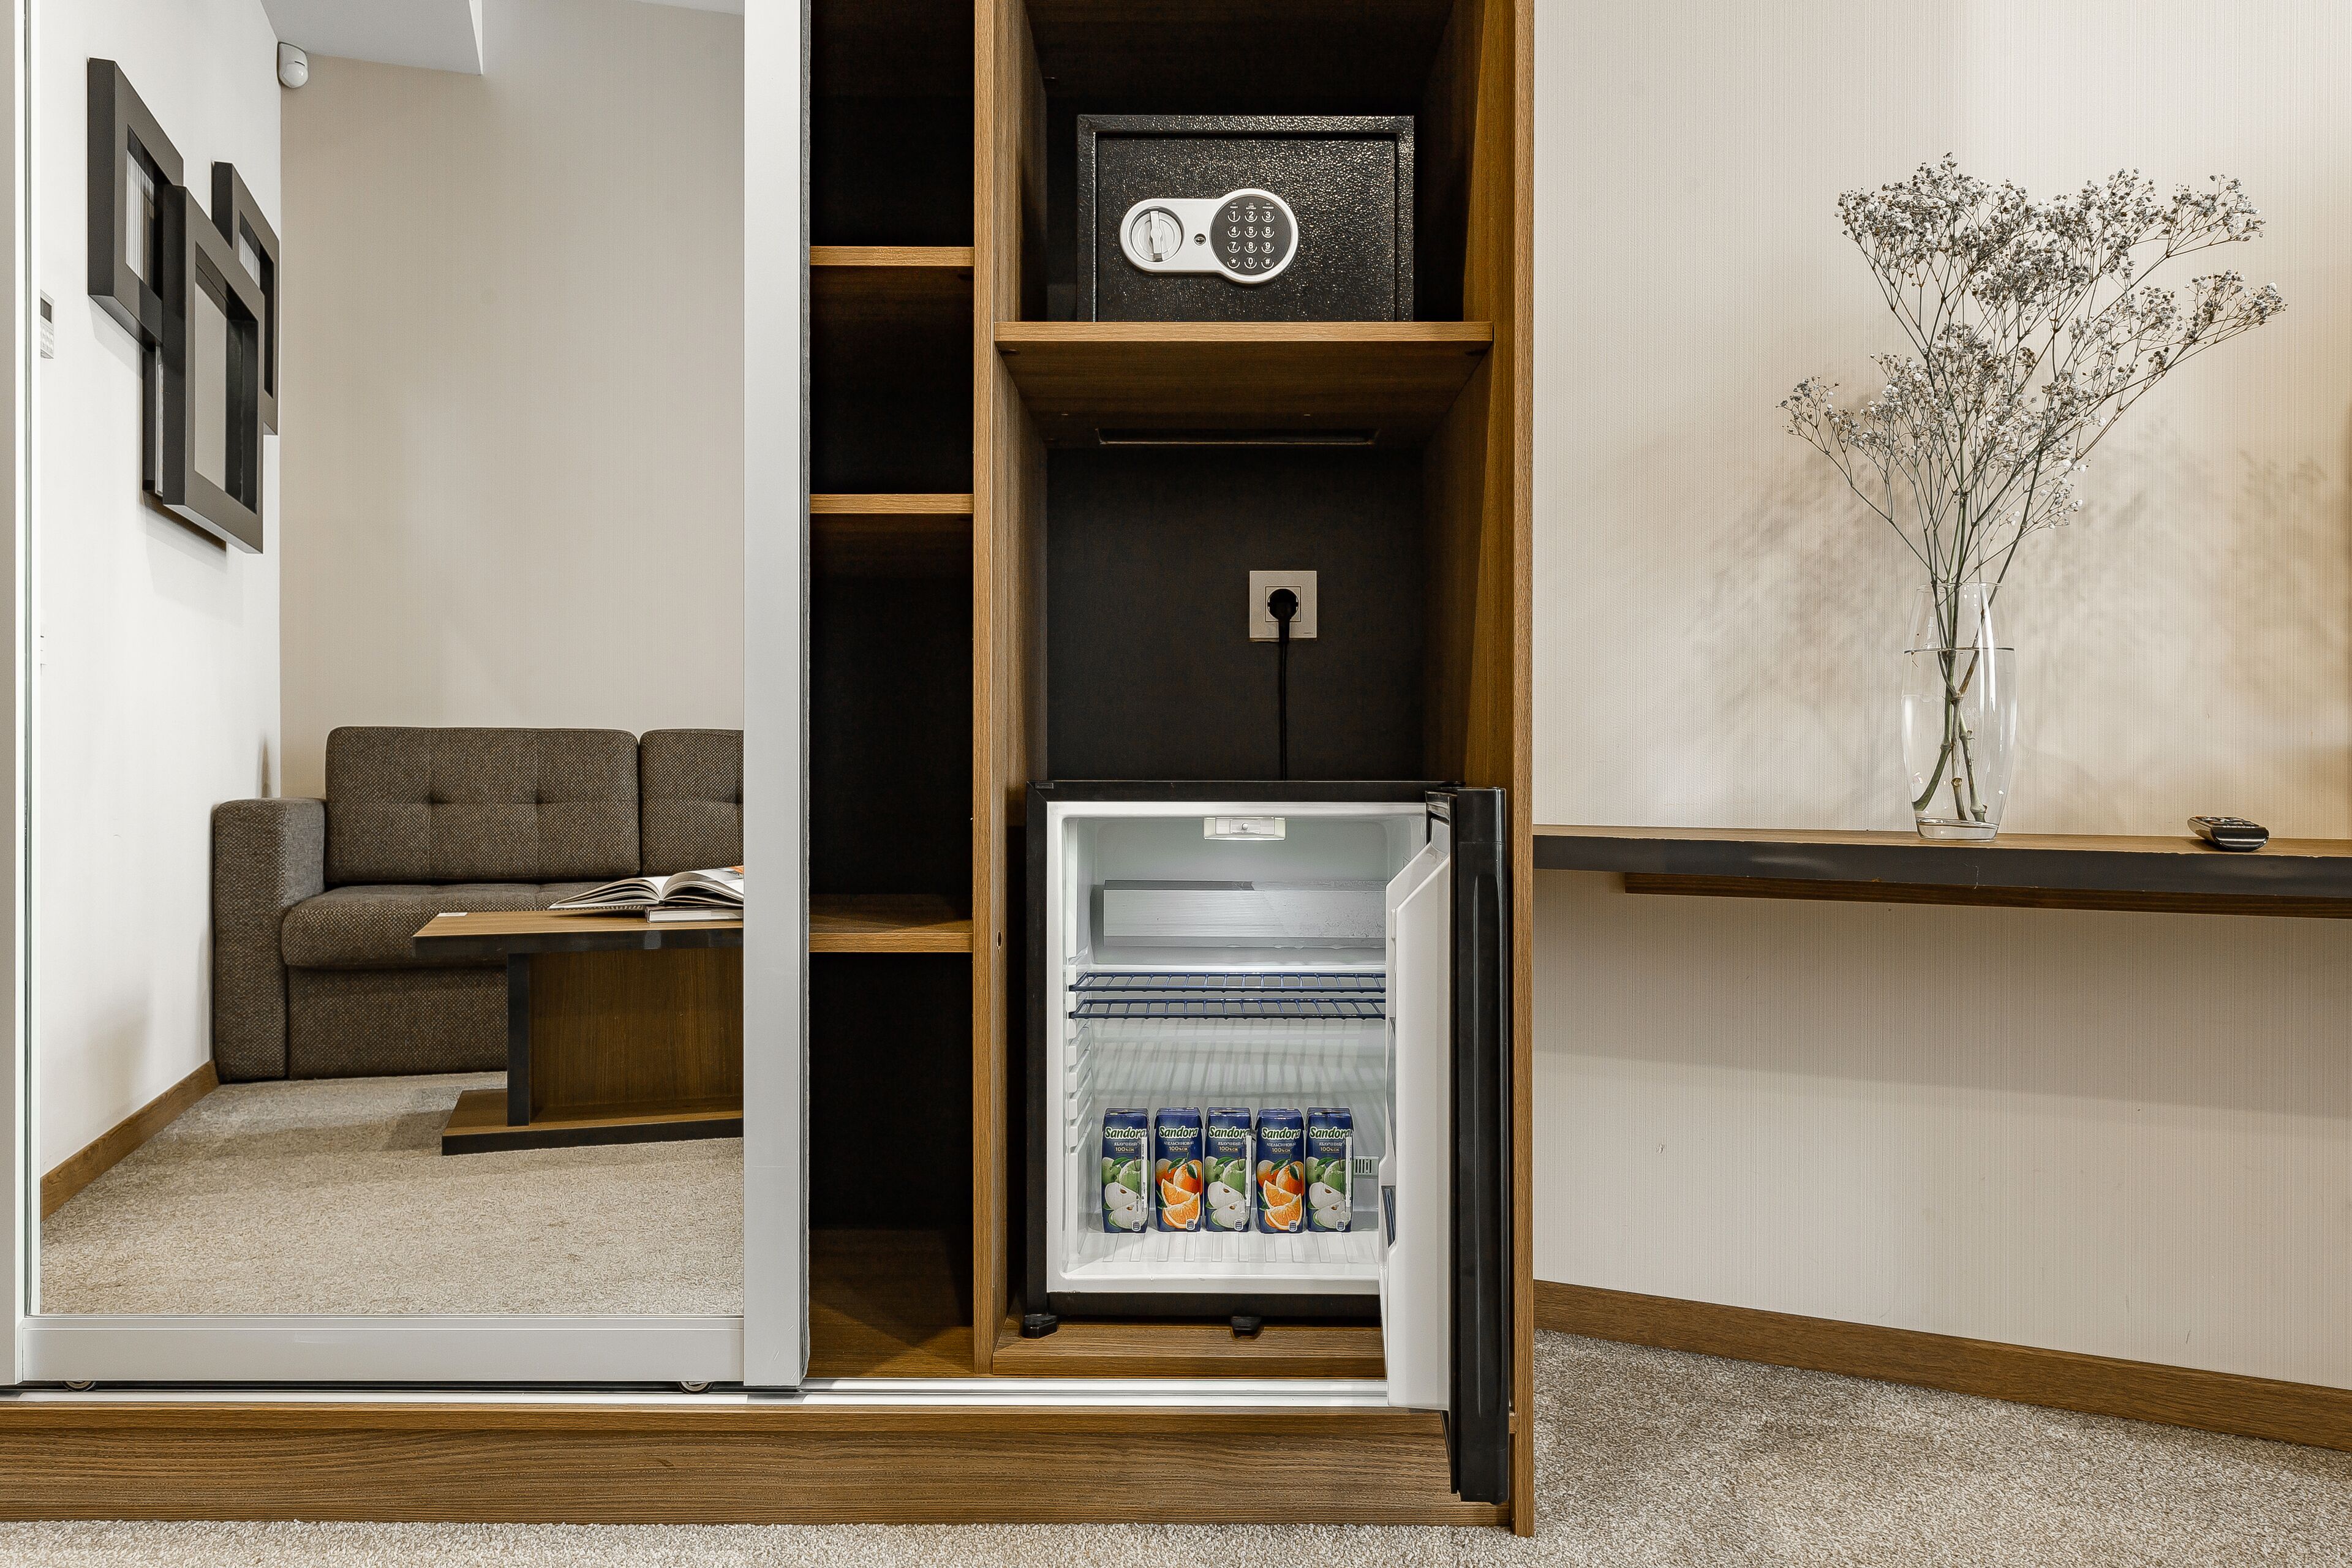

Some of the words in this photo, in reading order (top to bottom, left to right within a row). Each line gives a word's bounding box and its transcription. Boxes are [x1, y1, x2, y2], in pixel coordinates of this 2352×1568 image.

[1104, 1126, 1147, 1139] Sandora
[1159, 1125, 1199, 1139] Sandora
[1208, 1126, 1250, 1139] Sandora
[1262, 1126, 1301, 1140] Sandora
[1310, 1126, 1351, 1139] Sandora
